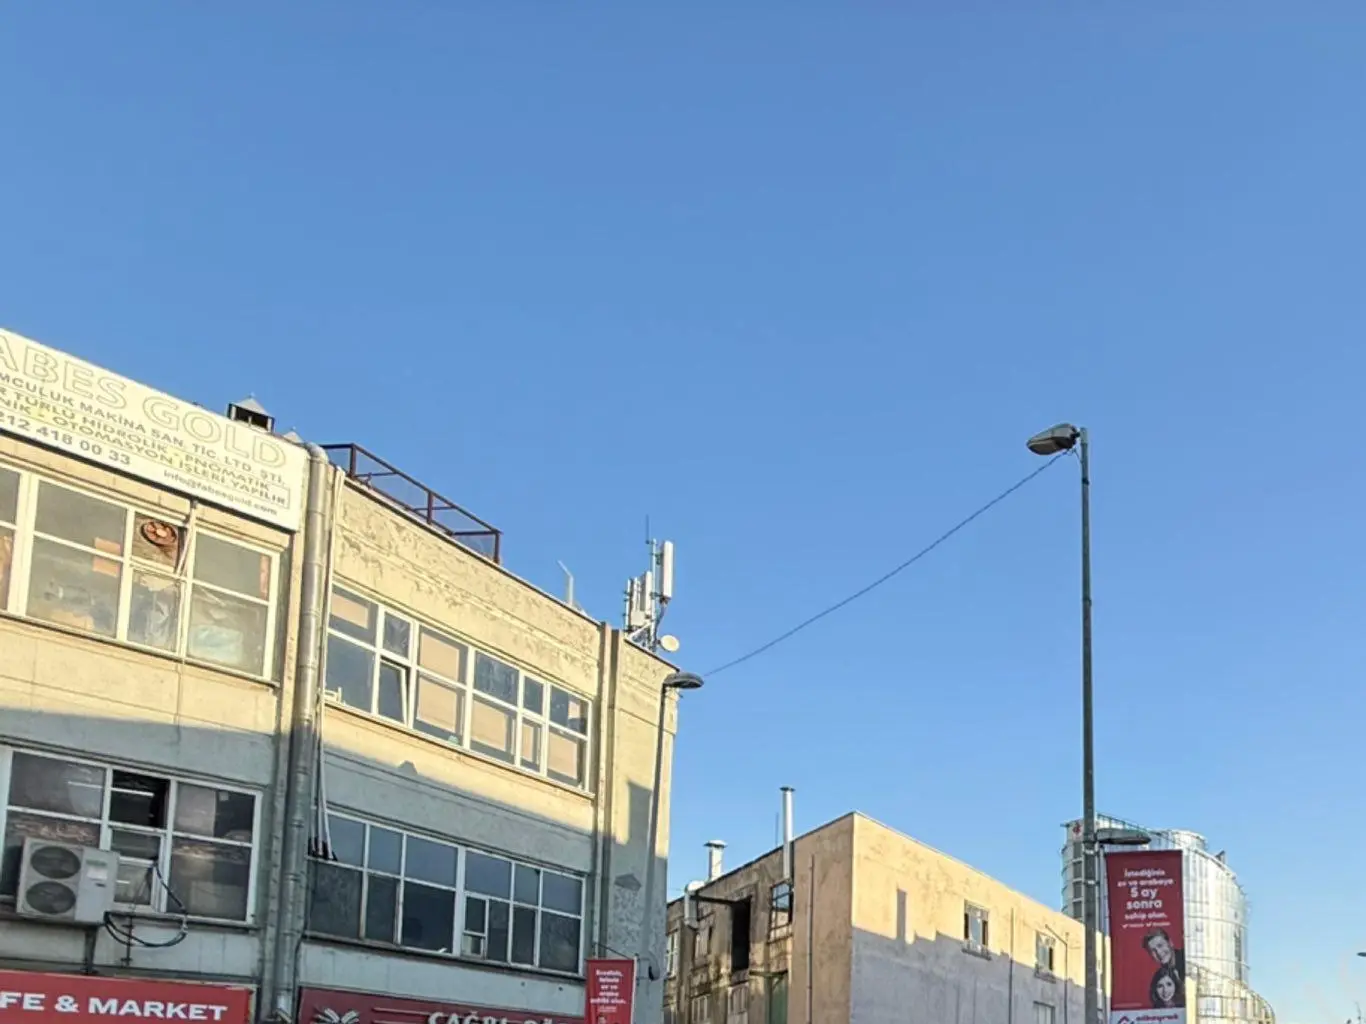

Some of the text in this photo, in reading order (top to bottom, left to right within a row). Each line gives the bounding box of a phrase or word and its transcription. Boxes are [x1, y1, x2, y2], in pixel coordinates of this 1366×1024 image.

[36, 426, 73, 446] 418
[79, 440, 102, 456] 00
[108, 449, 131, 466] 33
[52, 415, 173, 466] OTOMASYON
[142, 396, 286, 469] GOLD
[1126, 899, 1163, 910] sonra
[1130, 887, 1158, 899] 5 ay
[0, 990, 229, 1021] FE & MARKET
